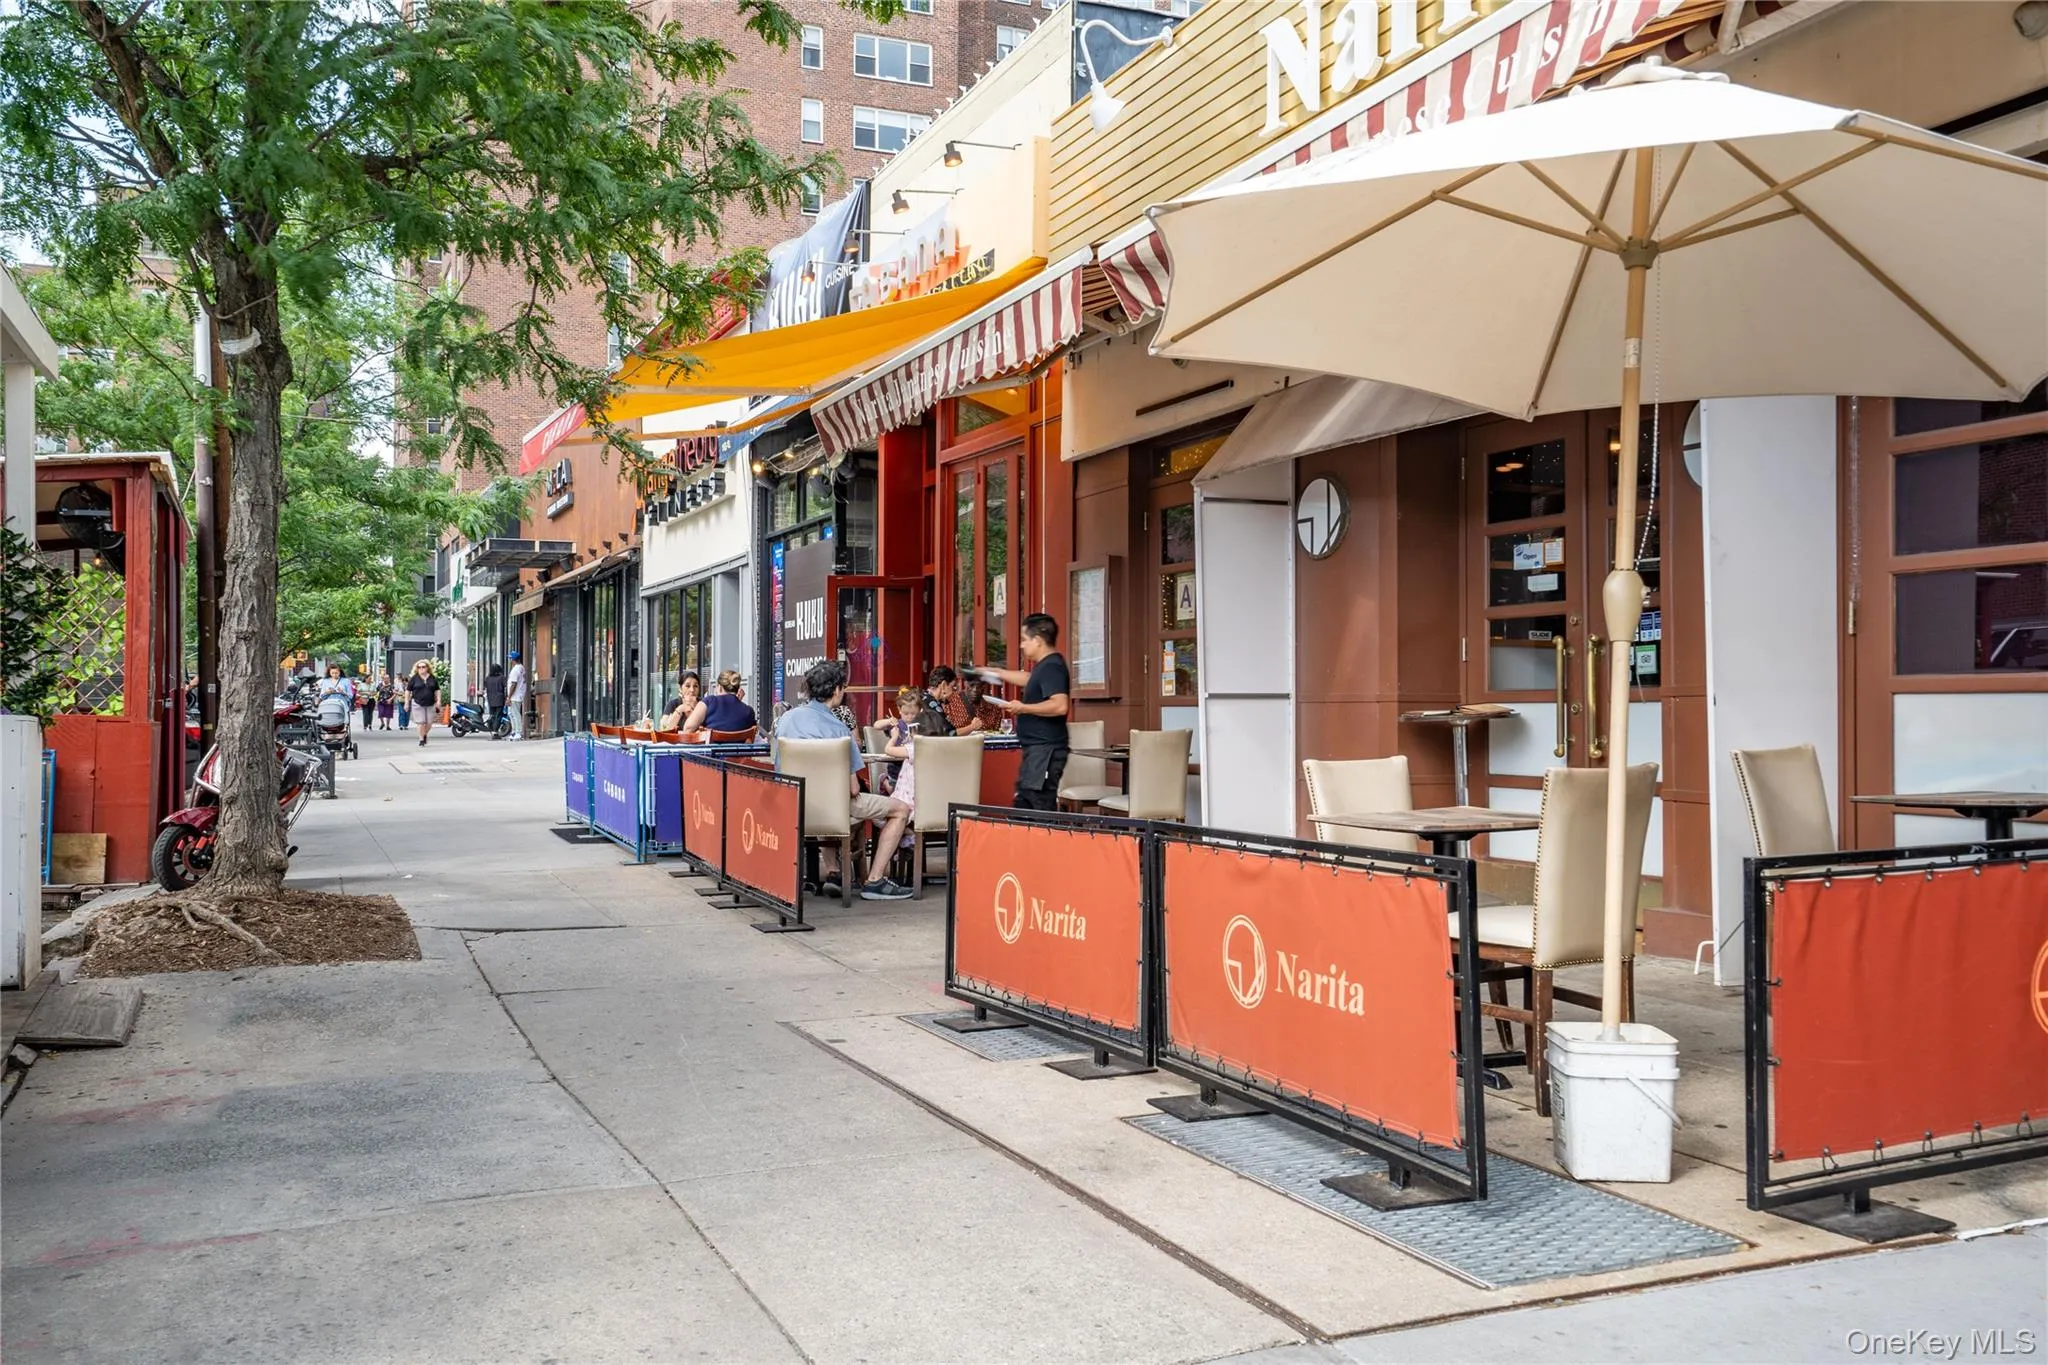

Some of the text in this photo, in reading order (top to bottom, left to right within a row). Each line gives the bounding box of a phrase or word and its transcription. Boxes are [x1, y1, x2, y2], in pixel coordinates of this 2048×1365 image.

[825, 259, 855, 288] CUISINE
[996, 582, 1004, 601] A
[1180, 584, 1192, 609] A
[603, 779, 626, 804] CABANA
[755, 822, 779, 851] Narita
[1028, 896, 1087, 942] Narita
[1275, 950, 1365, 1016] Narita
